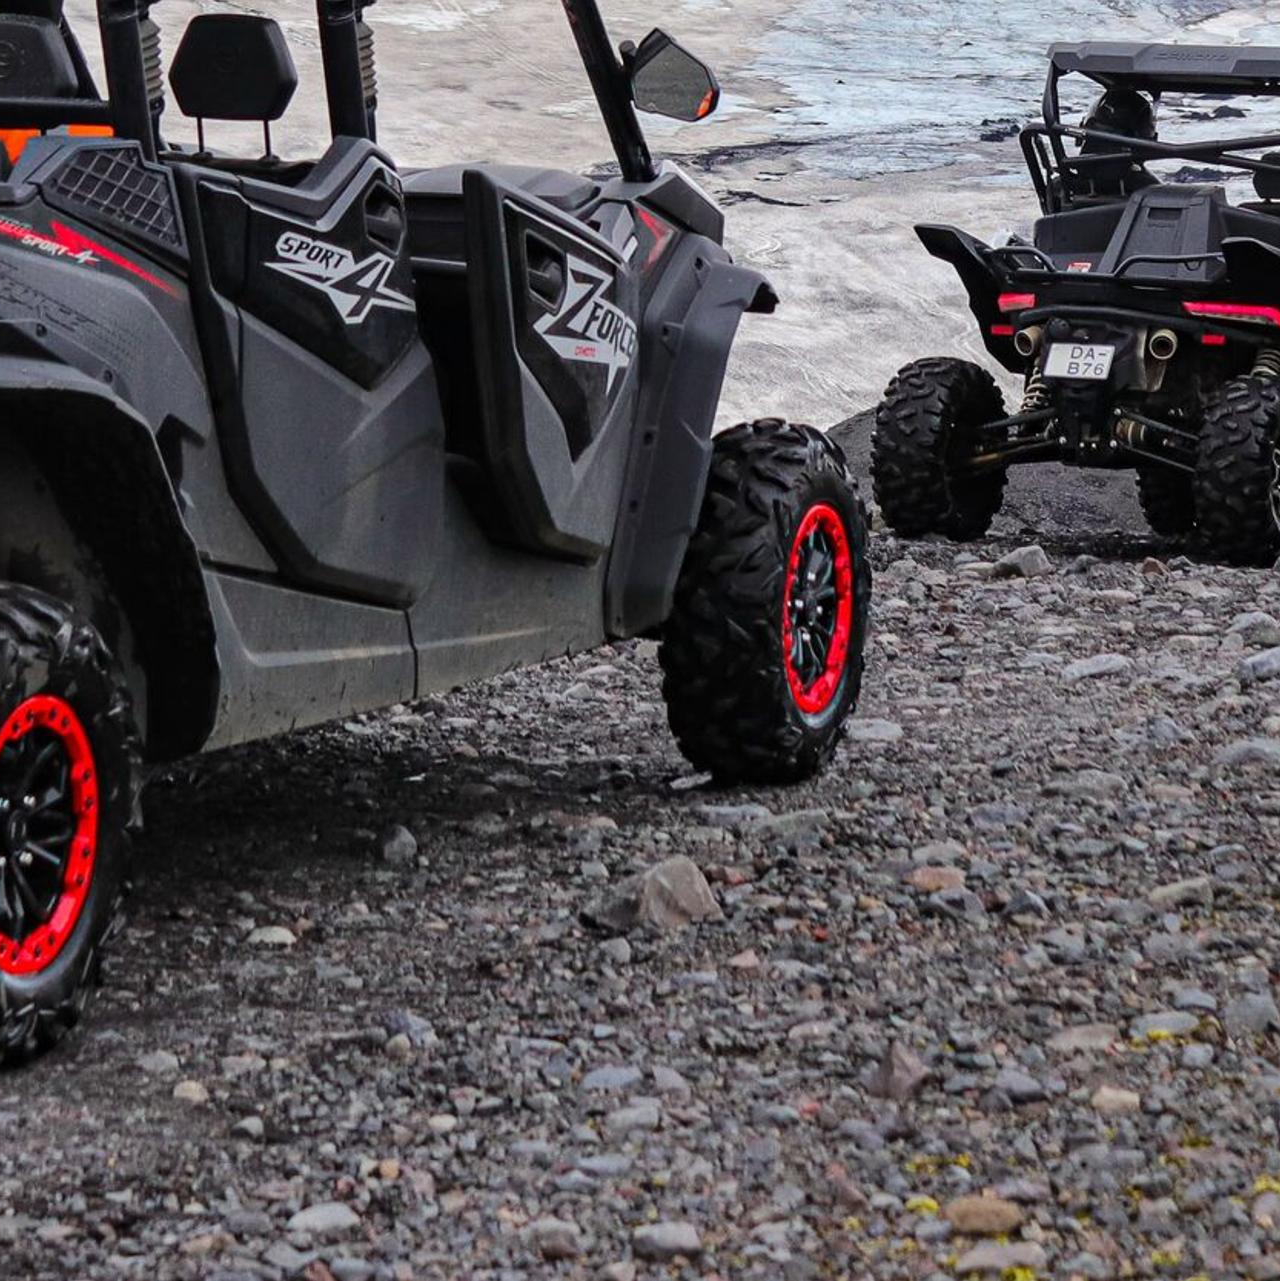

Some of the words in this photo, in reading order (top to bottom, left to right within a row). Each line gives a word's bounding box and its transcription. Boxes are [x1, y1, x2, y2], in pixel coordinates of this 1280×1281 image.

[280, 236, 347, 269] SPORT
[1070, 345, 1108, 360] DA-
[1067, 361, 1105, 376] B76
